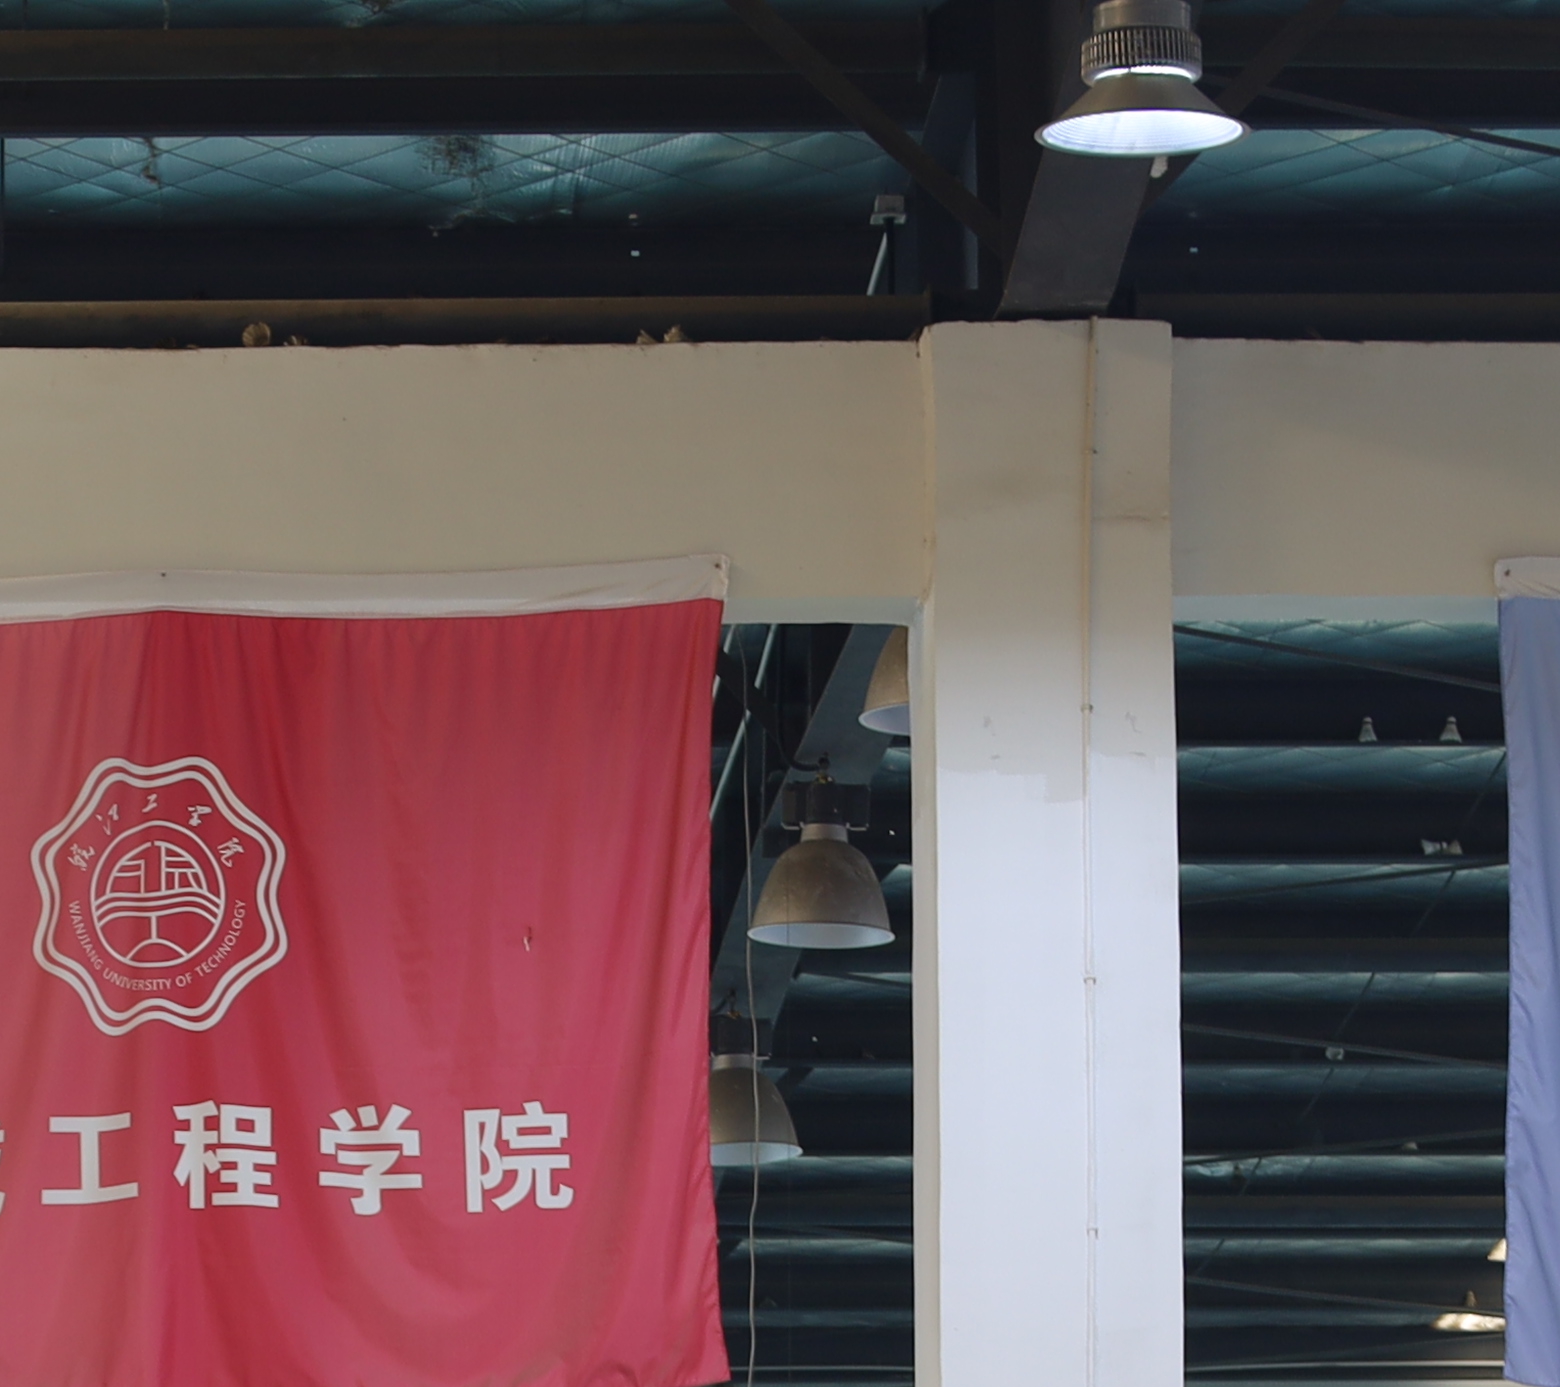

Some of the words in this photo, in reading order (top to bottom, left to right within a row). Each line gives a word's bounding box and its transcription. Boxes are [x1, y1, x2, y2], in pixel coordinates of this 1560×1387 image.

[68, 900, 103, 971] WANJIANG
[103, 968, 172, 992] UNIVERSITY
[176, 974, 194, 989] OF
[194, 899, 247, 978] TECHNOLOGY
